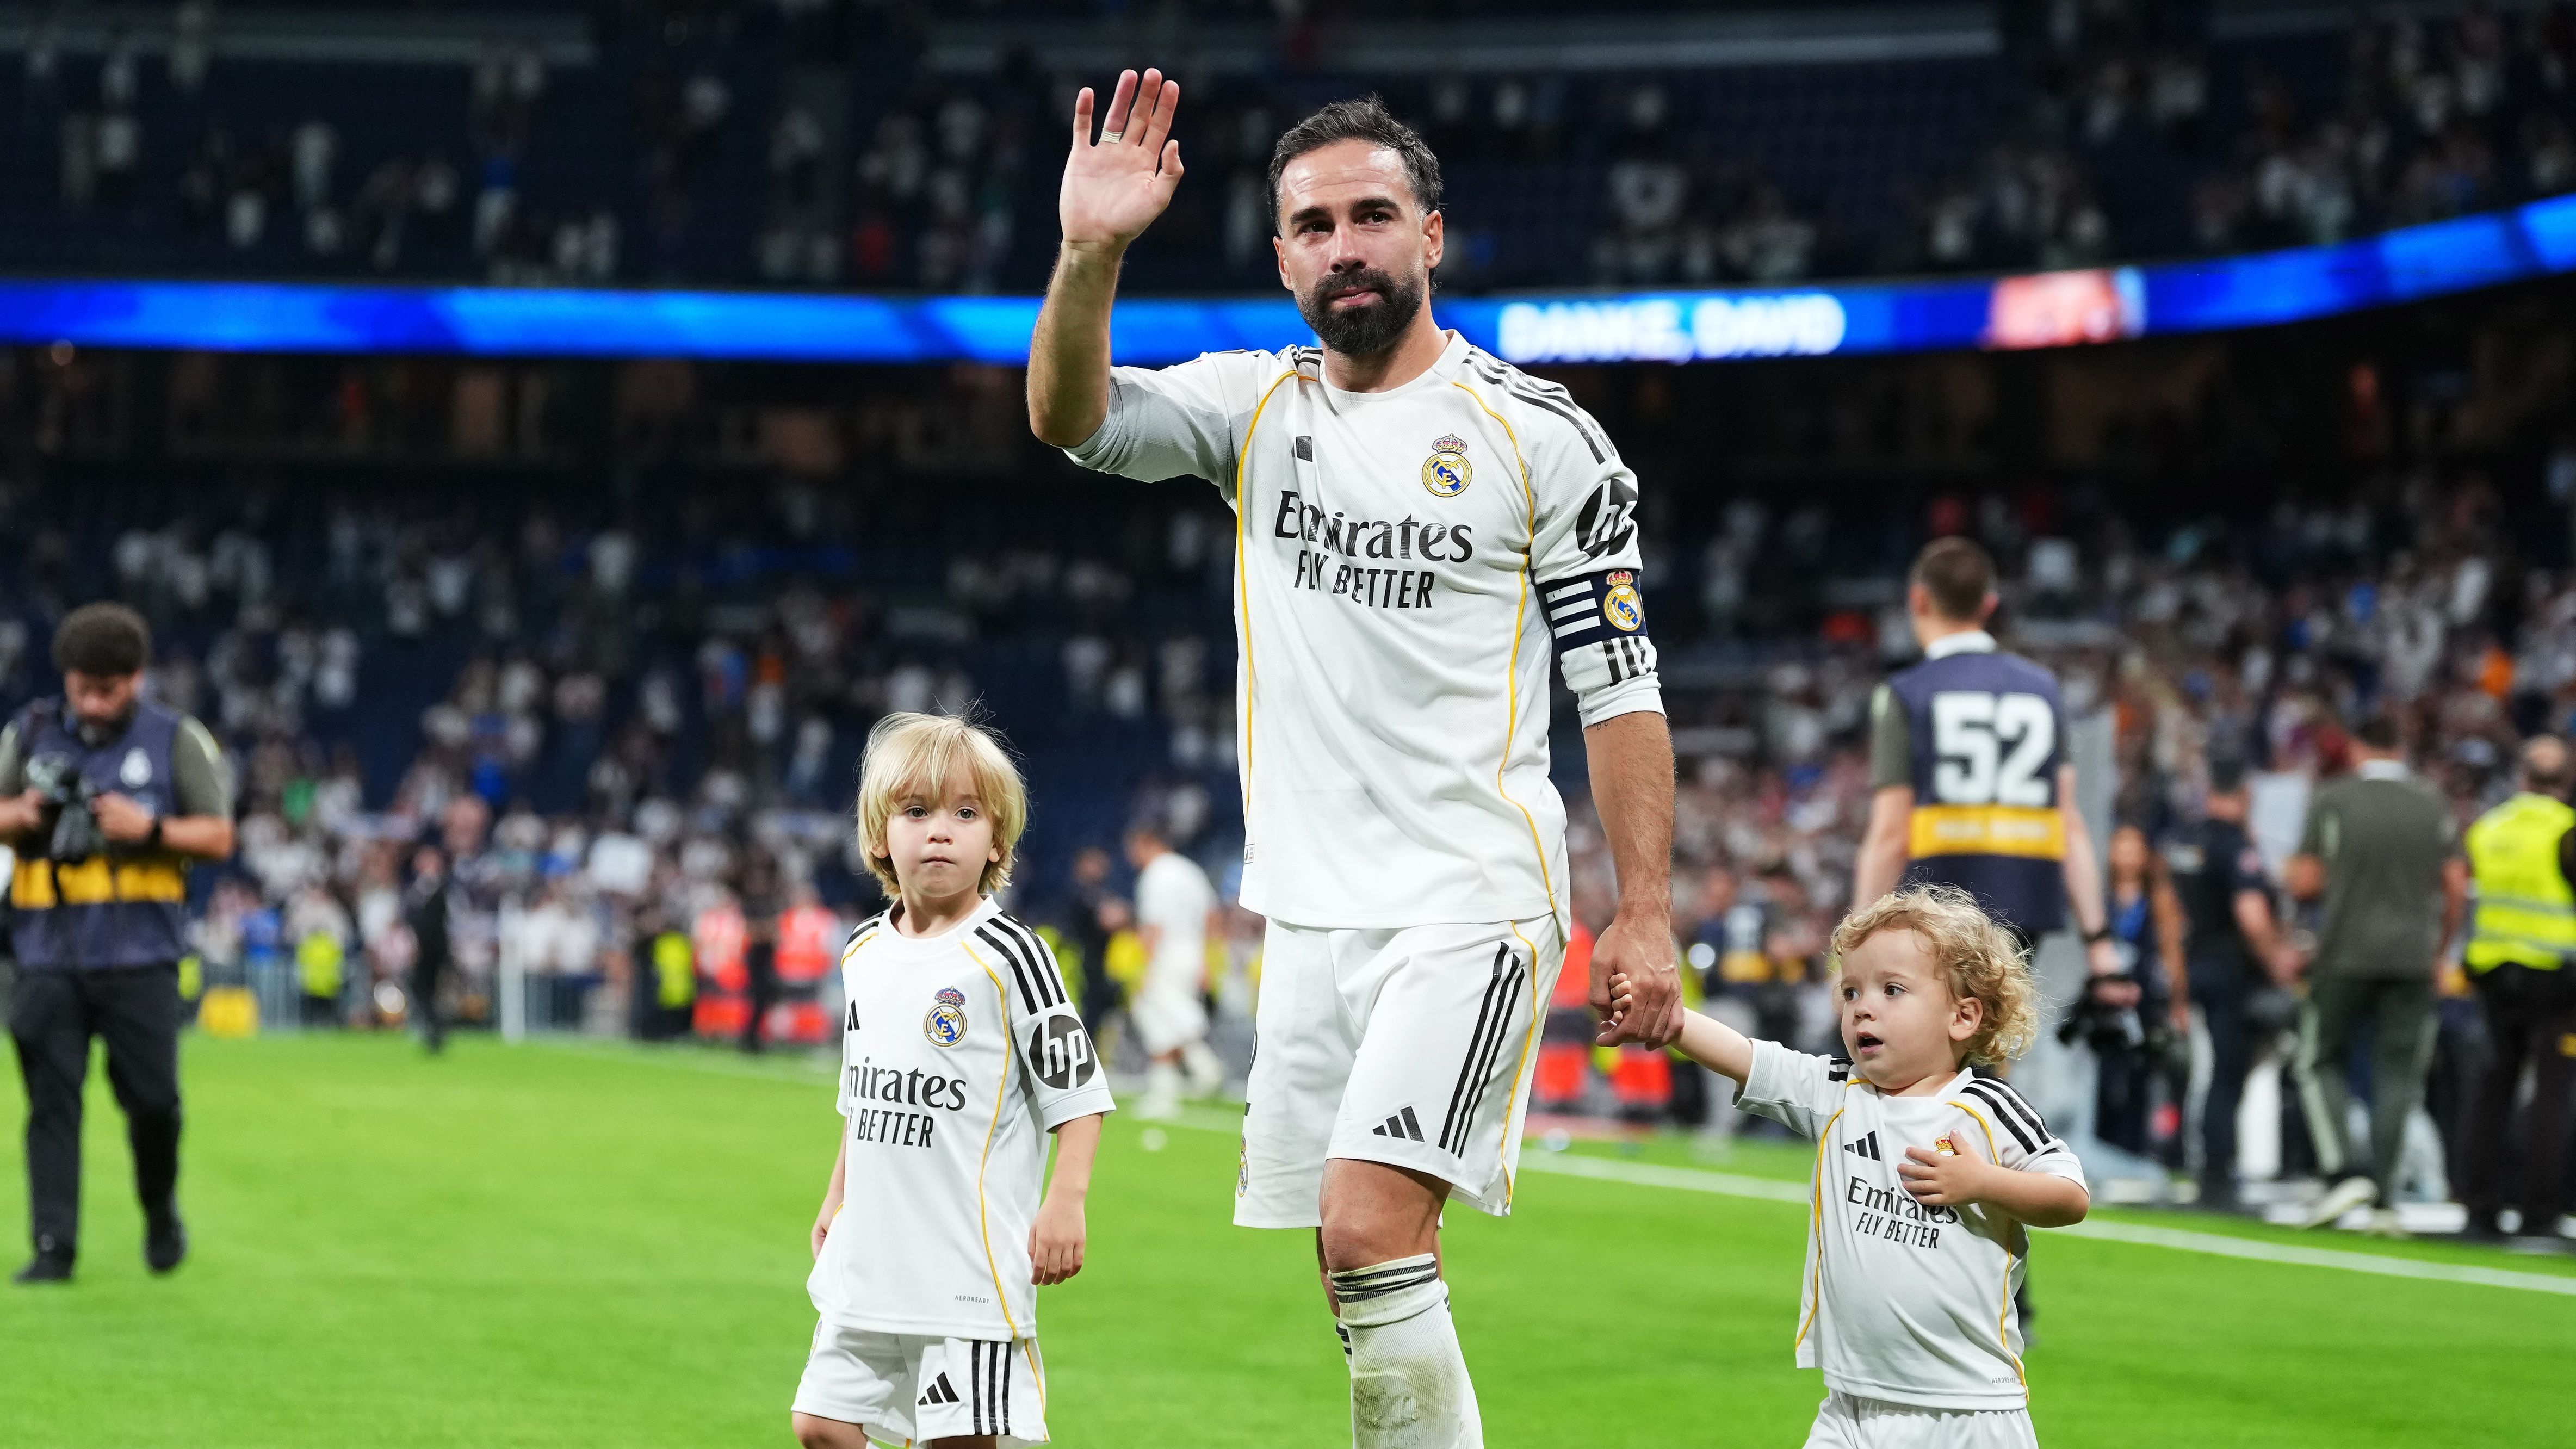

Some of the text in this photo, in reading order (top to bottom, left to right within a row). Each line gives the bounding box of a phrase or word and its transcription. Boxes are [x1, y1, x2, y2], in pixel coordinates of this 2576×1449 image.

[1275, 490, 1473, 563] Emirates
[1294, 550, 1435, 609] FLY BETTER
[1933, 690, 2057, 807] 52
[1040, 1017, 1088, 1089] hp
[848, 1056, 967, 1111] mirates
[857, 1107, 933, 1148] BETTER
[1856, 1212, 1940, 1249] FLY BETTER
[955, 1295, 990, 1304] AEROREADY
